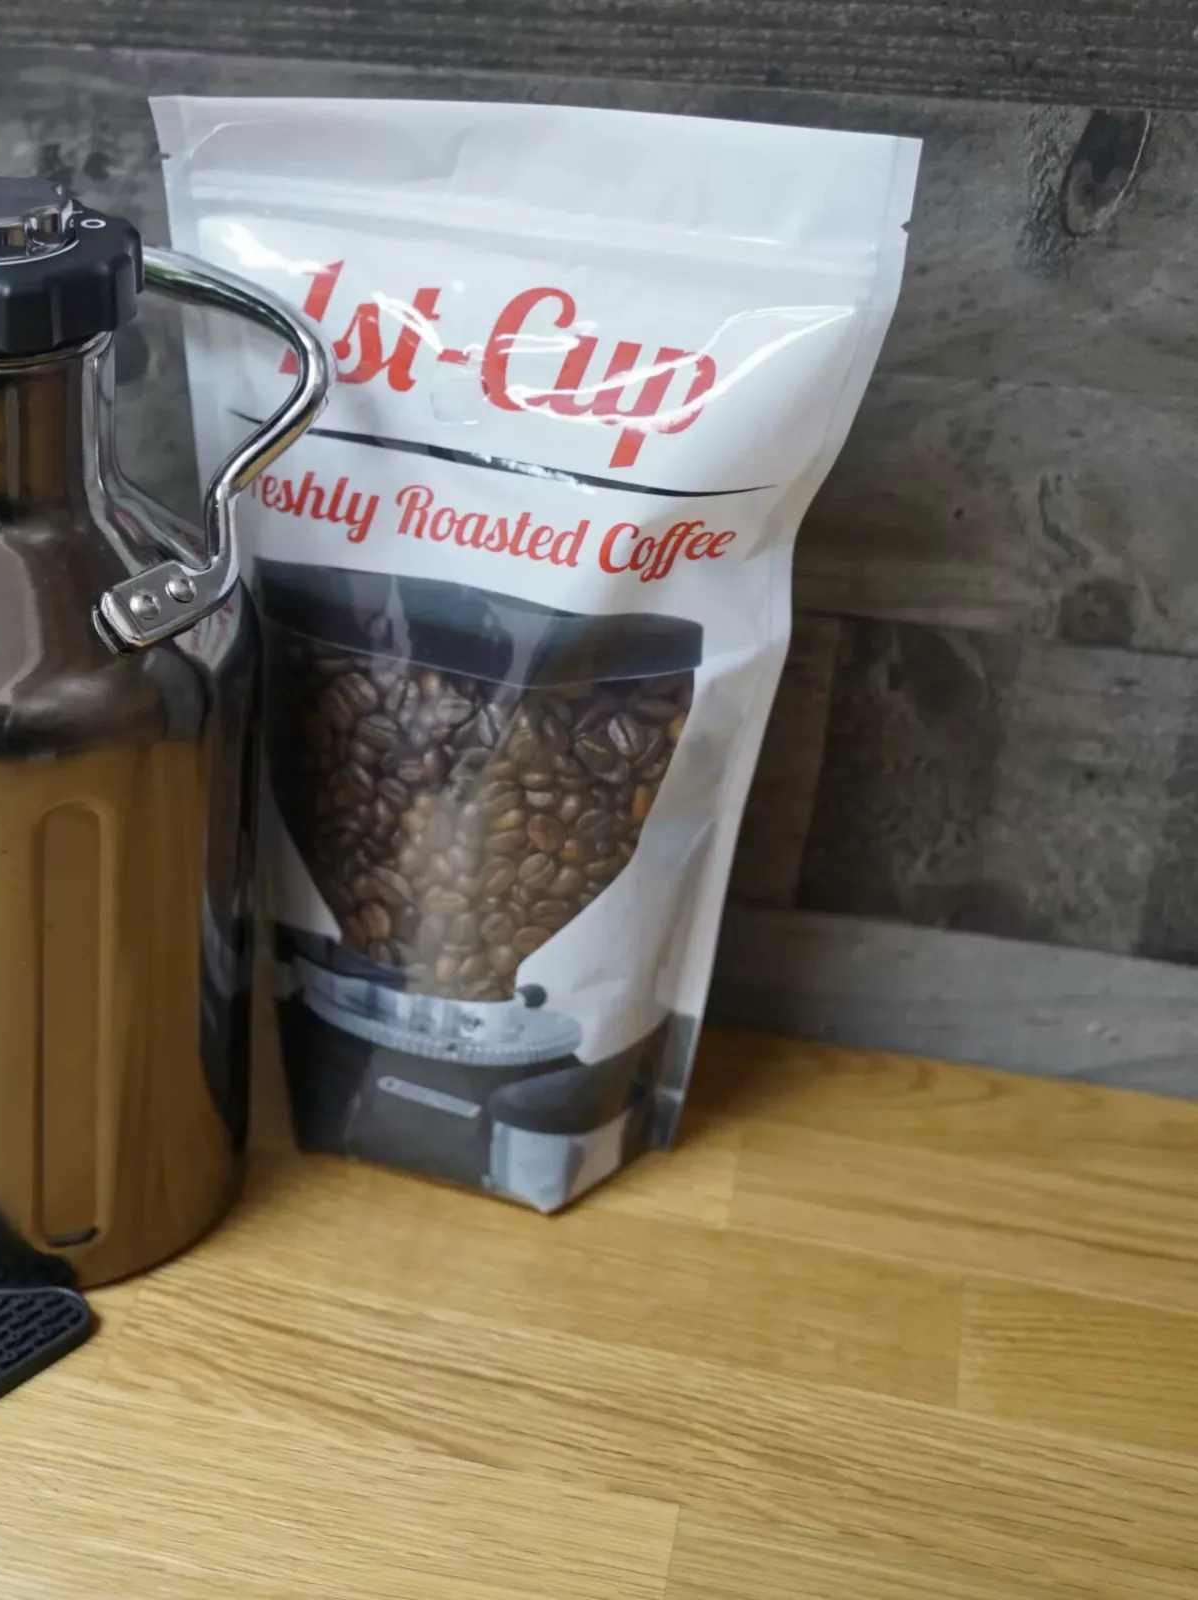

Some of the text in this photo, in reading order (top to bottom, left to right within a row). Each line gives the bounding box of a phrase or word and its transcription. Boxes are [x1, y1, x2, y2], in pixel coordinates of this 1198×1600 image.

[278, 259, 717, 468] 1st-Cup
[251, 470, 737, 583] reshly Roasted Coffee
